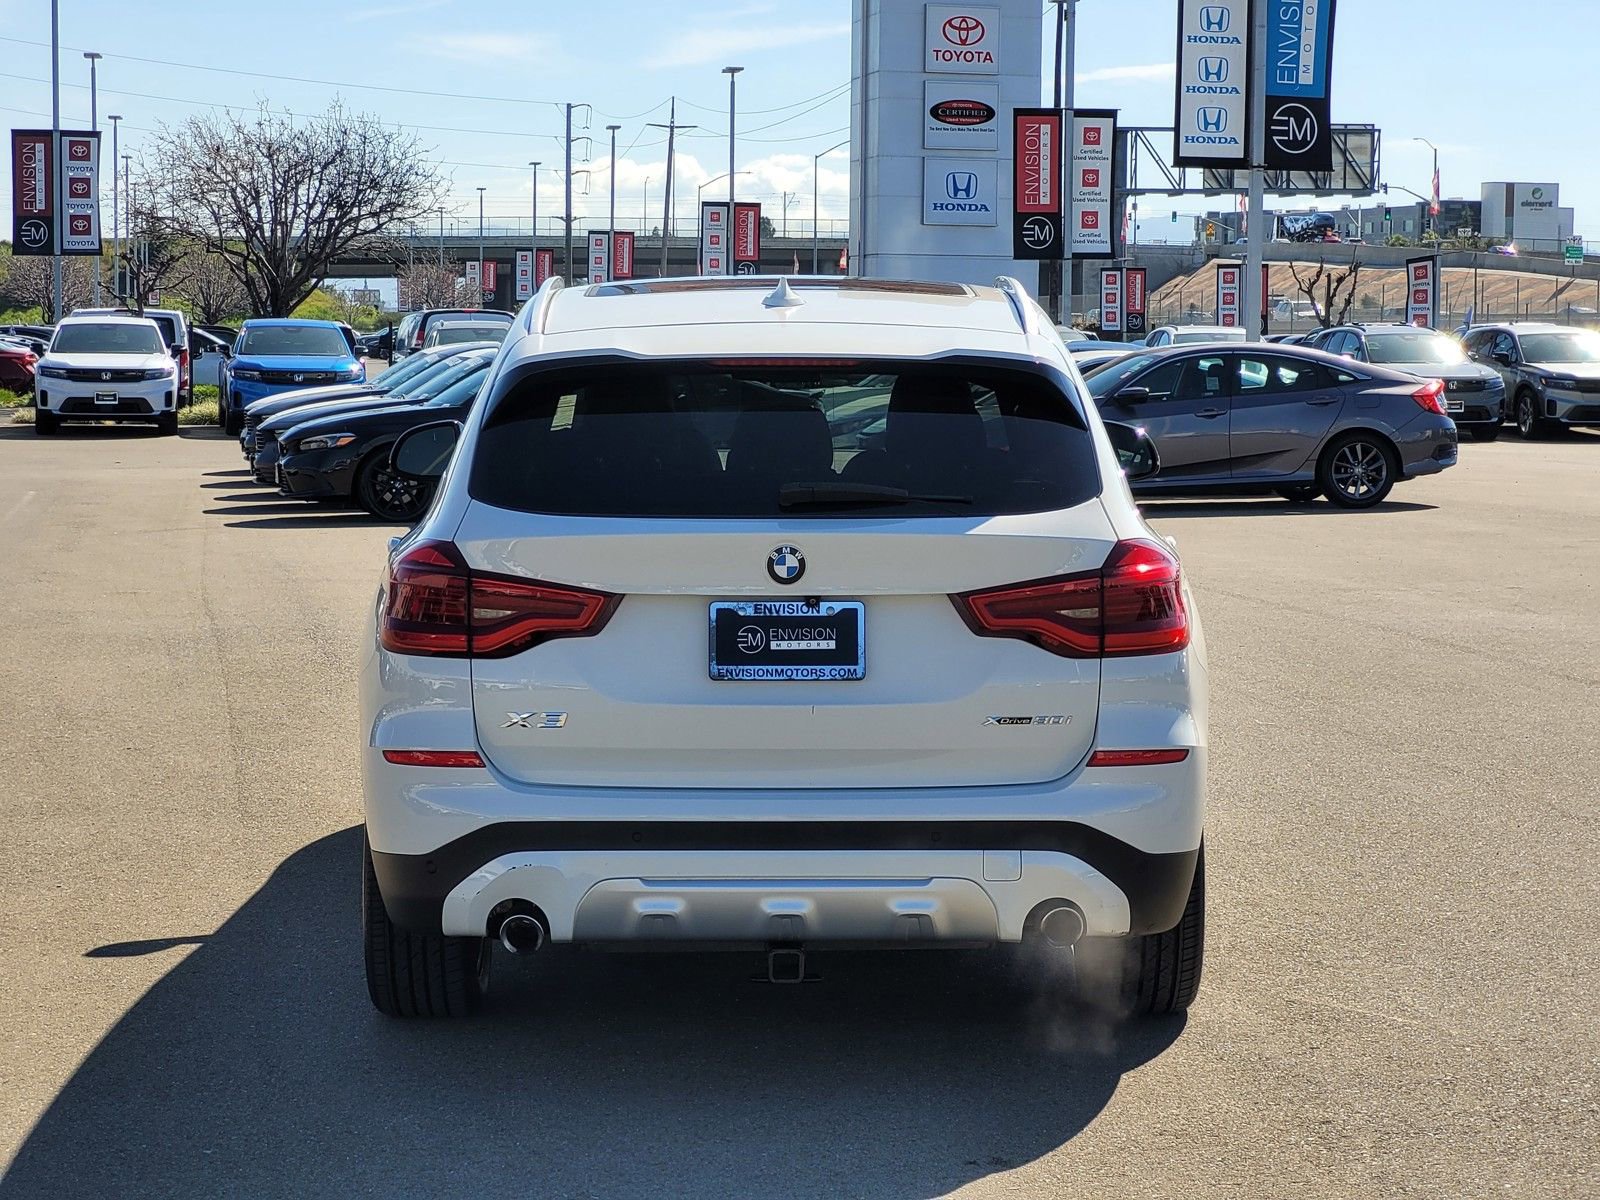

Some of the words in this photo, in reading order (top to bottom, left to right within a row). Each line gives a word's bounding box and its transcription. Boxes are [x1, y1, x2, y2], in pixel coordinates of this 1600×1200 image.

[1186, 35, 1242, 45] HONDA
[932, 49, 994, 64] TOYOTA
[1185, 85, 1241, 95] HONDA
[1184, 135, 1240, 145] HONDA
[65, 165, 95, 173] TOYOTA
[1024, 123, 1040, 205] ENVISION
[22, 142, 36, 210] ENVISION
[66, 202, 95, 210] TOYOTA
[932, 202, 991, 212] HONDA
[739, 210, 748, 256] ENVISION
[66, 239, 96, 247] TOYOTA
[770, 546, 803, 559] BMW
[753, 603, 820, 615] ENVISION
[770, 628, 836, 641] ENVISION
[718, 668, 858, 679] ENVISIONMOTORS.COM
[498, 711, 568, 728] X3
